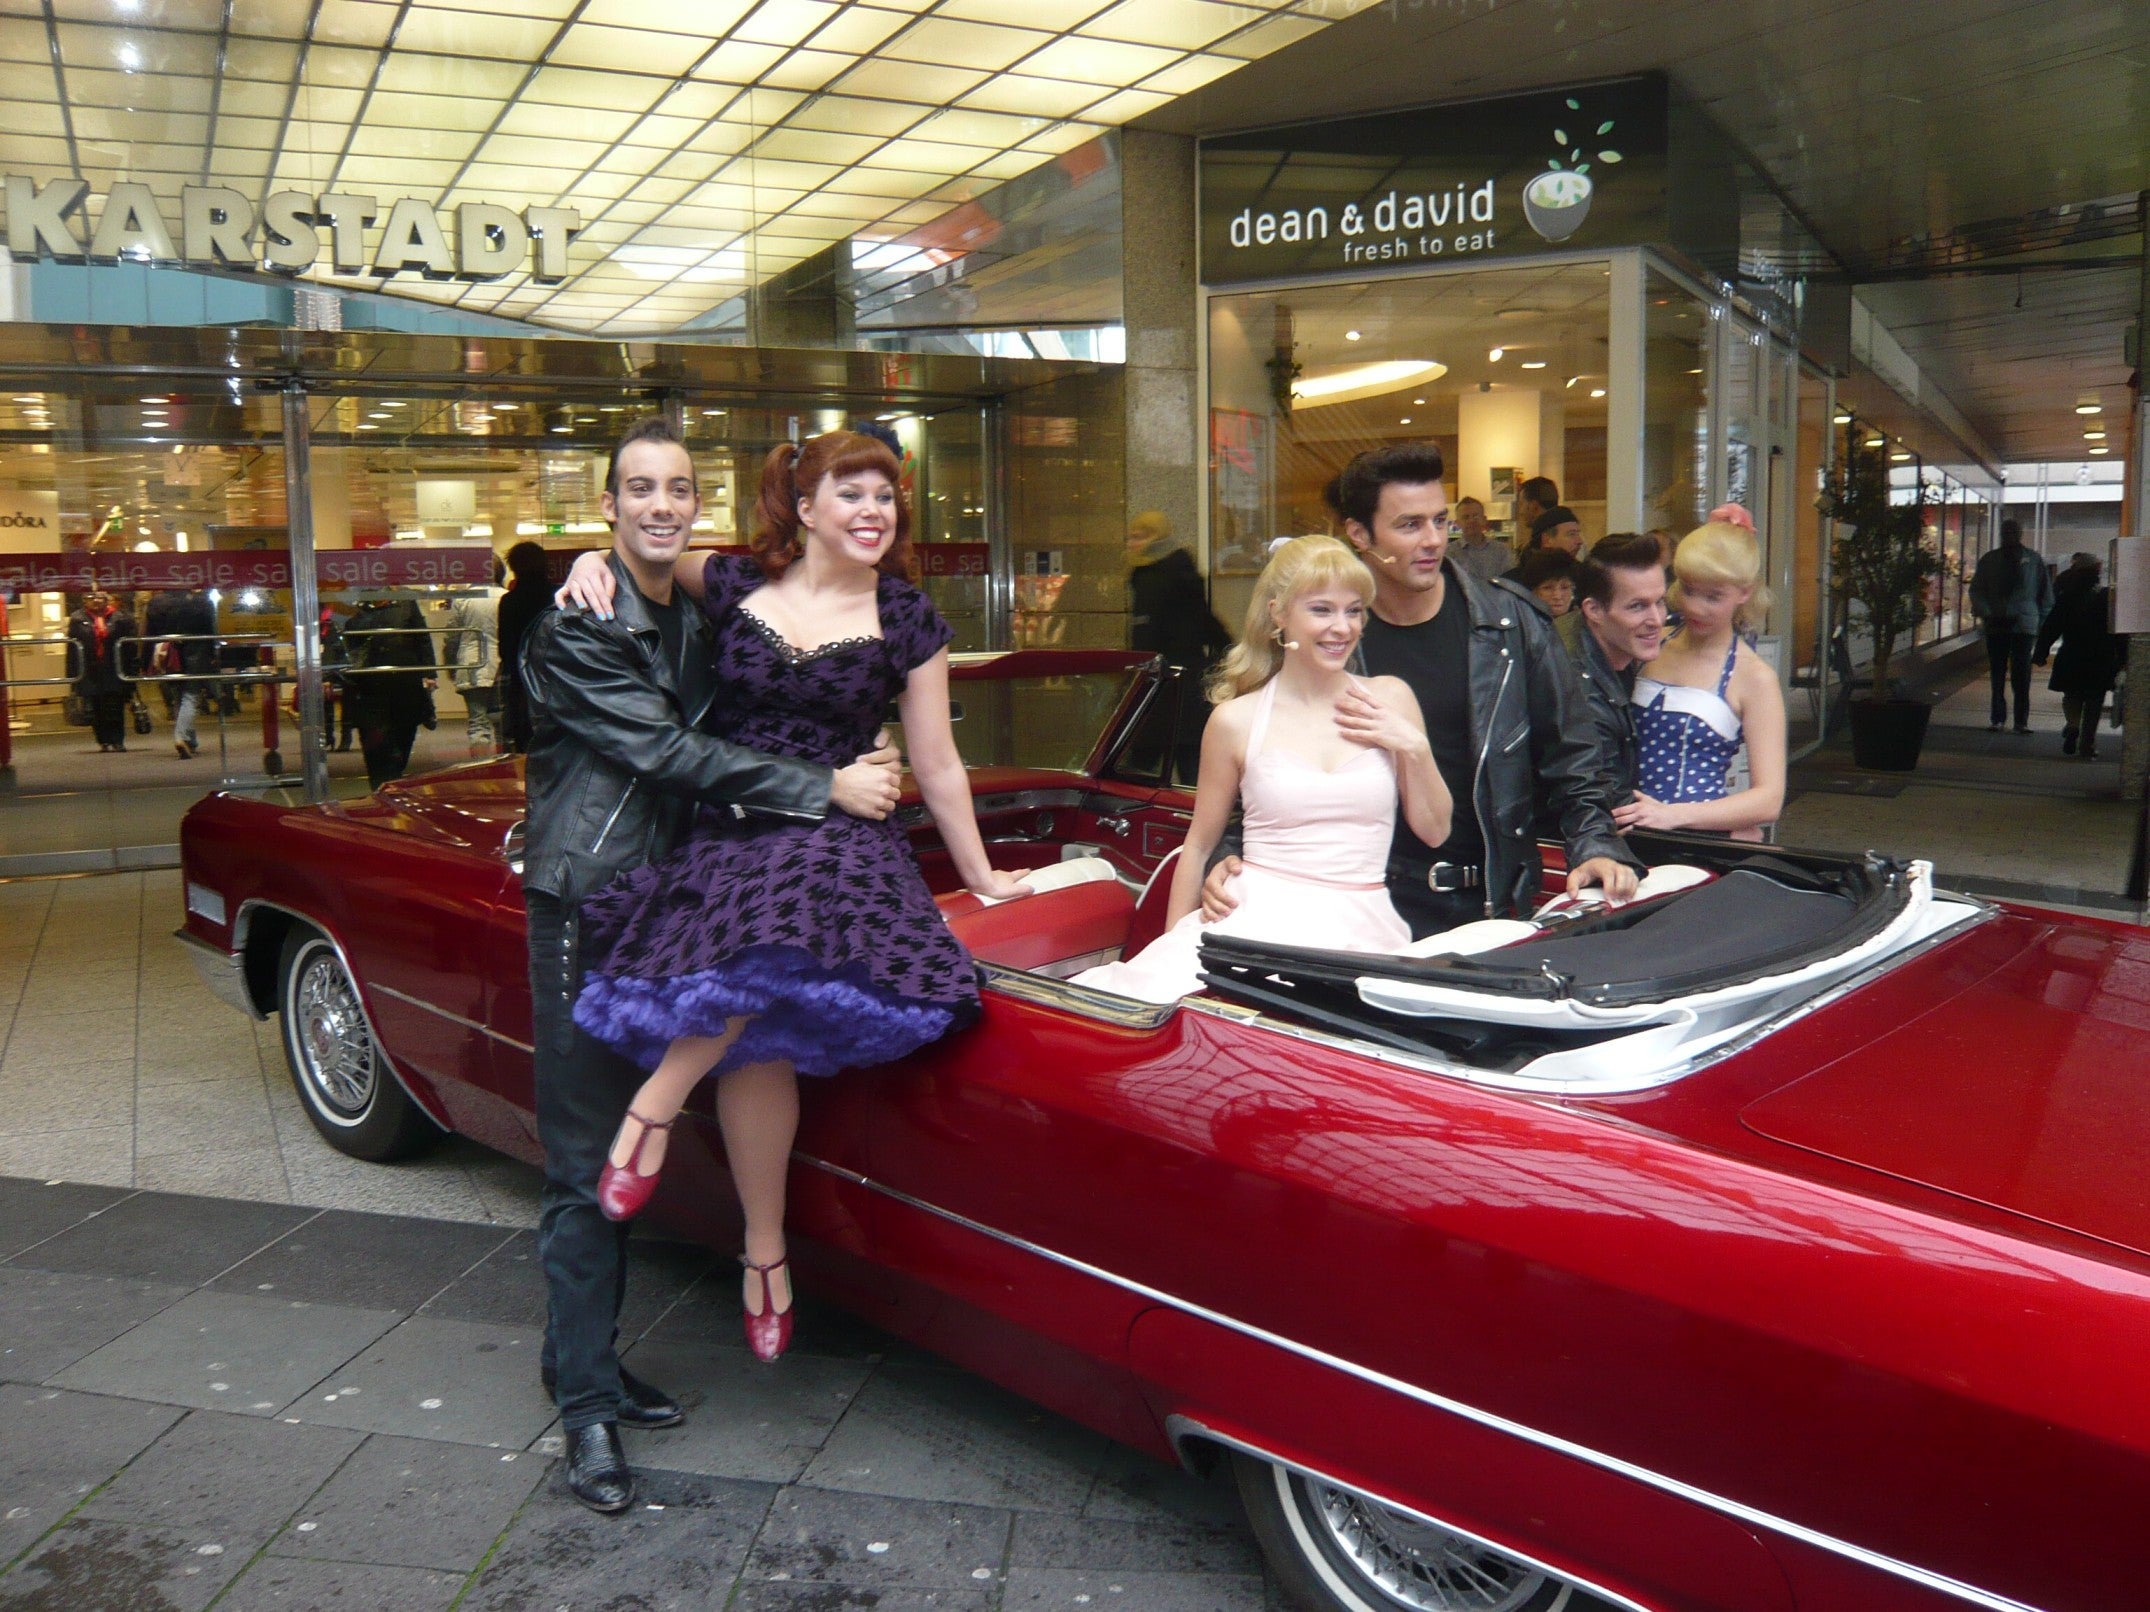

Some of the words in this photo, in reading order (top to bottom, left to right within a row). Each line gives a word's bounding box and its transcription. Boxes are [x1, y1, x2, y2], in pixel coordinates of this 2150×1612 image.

[5, 174, 580, 285] KARSTADT
[1230, 208, 1328, 248] dean
[1340, 203, 1364, 236] &
[1374, 179, 1494, 232] david
[1343, 237, 1408, 262] fresh
[1419, 236, 1443, 255] to
[1454, 229, 1495, 252] eat
[167, 558, 234, 588] sale
[325, 556, 388, 582] sale
[405, 554, 466, 581] sale
